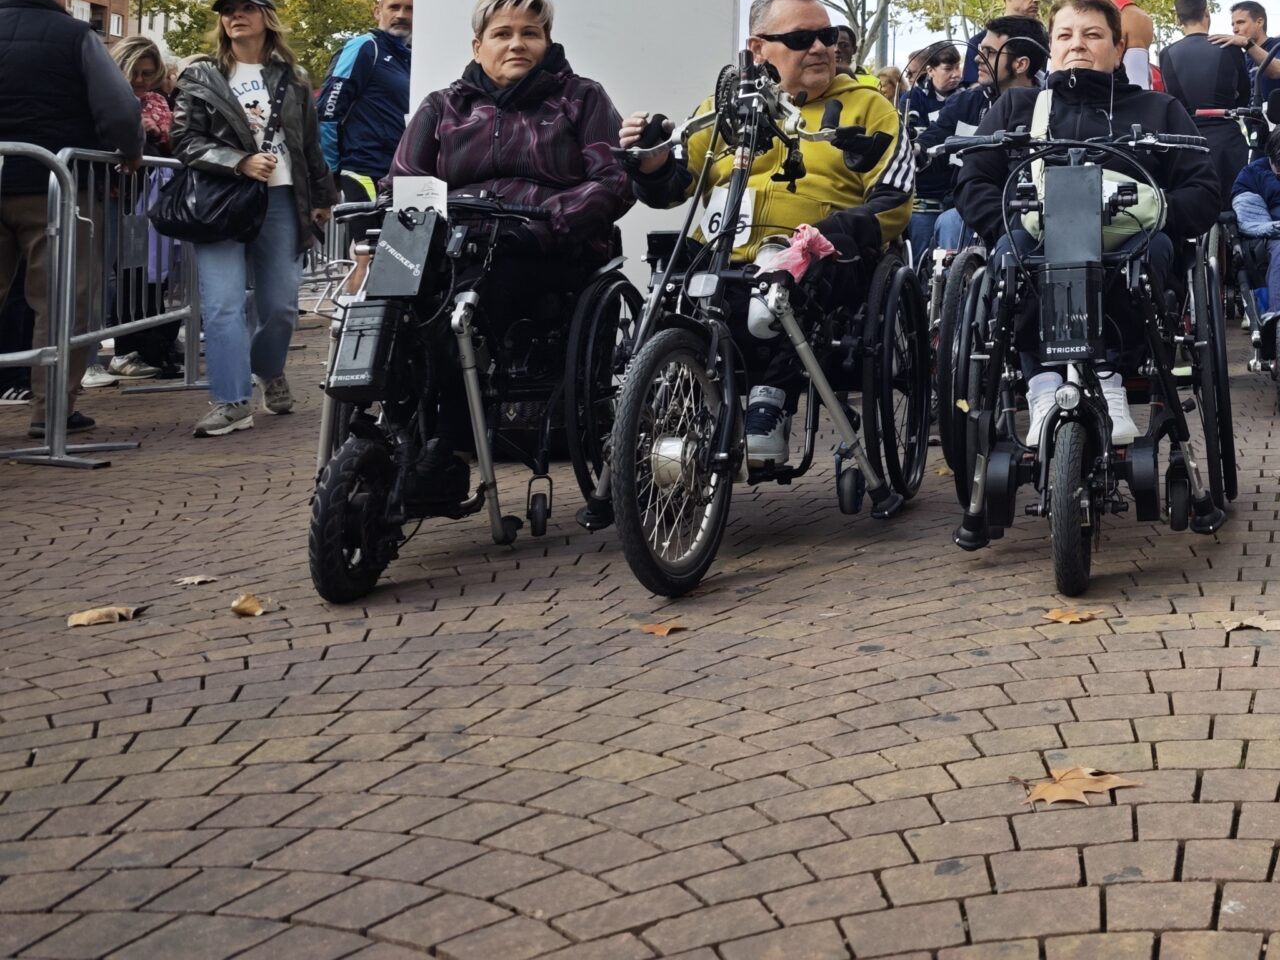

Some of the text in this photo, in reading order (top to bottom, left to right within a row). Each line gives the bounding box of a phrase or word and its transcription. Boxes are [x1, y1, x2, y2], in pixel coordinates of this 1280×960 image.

[707, 211, 750, 235] 65
[379, 240, 416, 271] STRICKER
[1046, 345, 1087, 355] STRICKER
